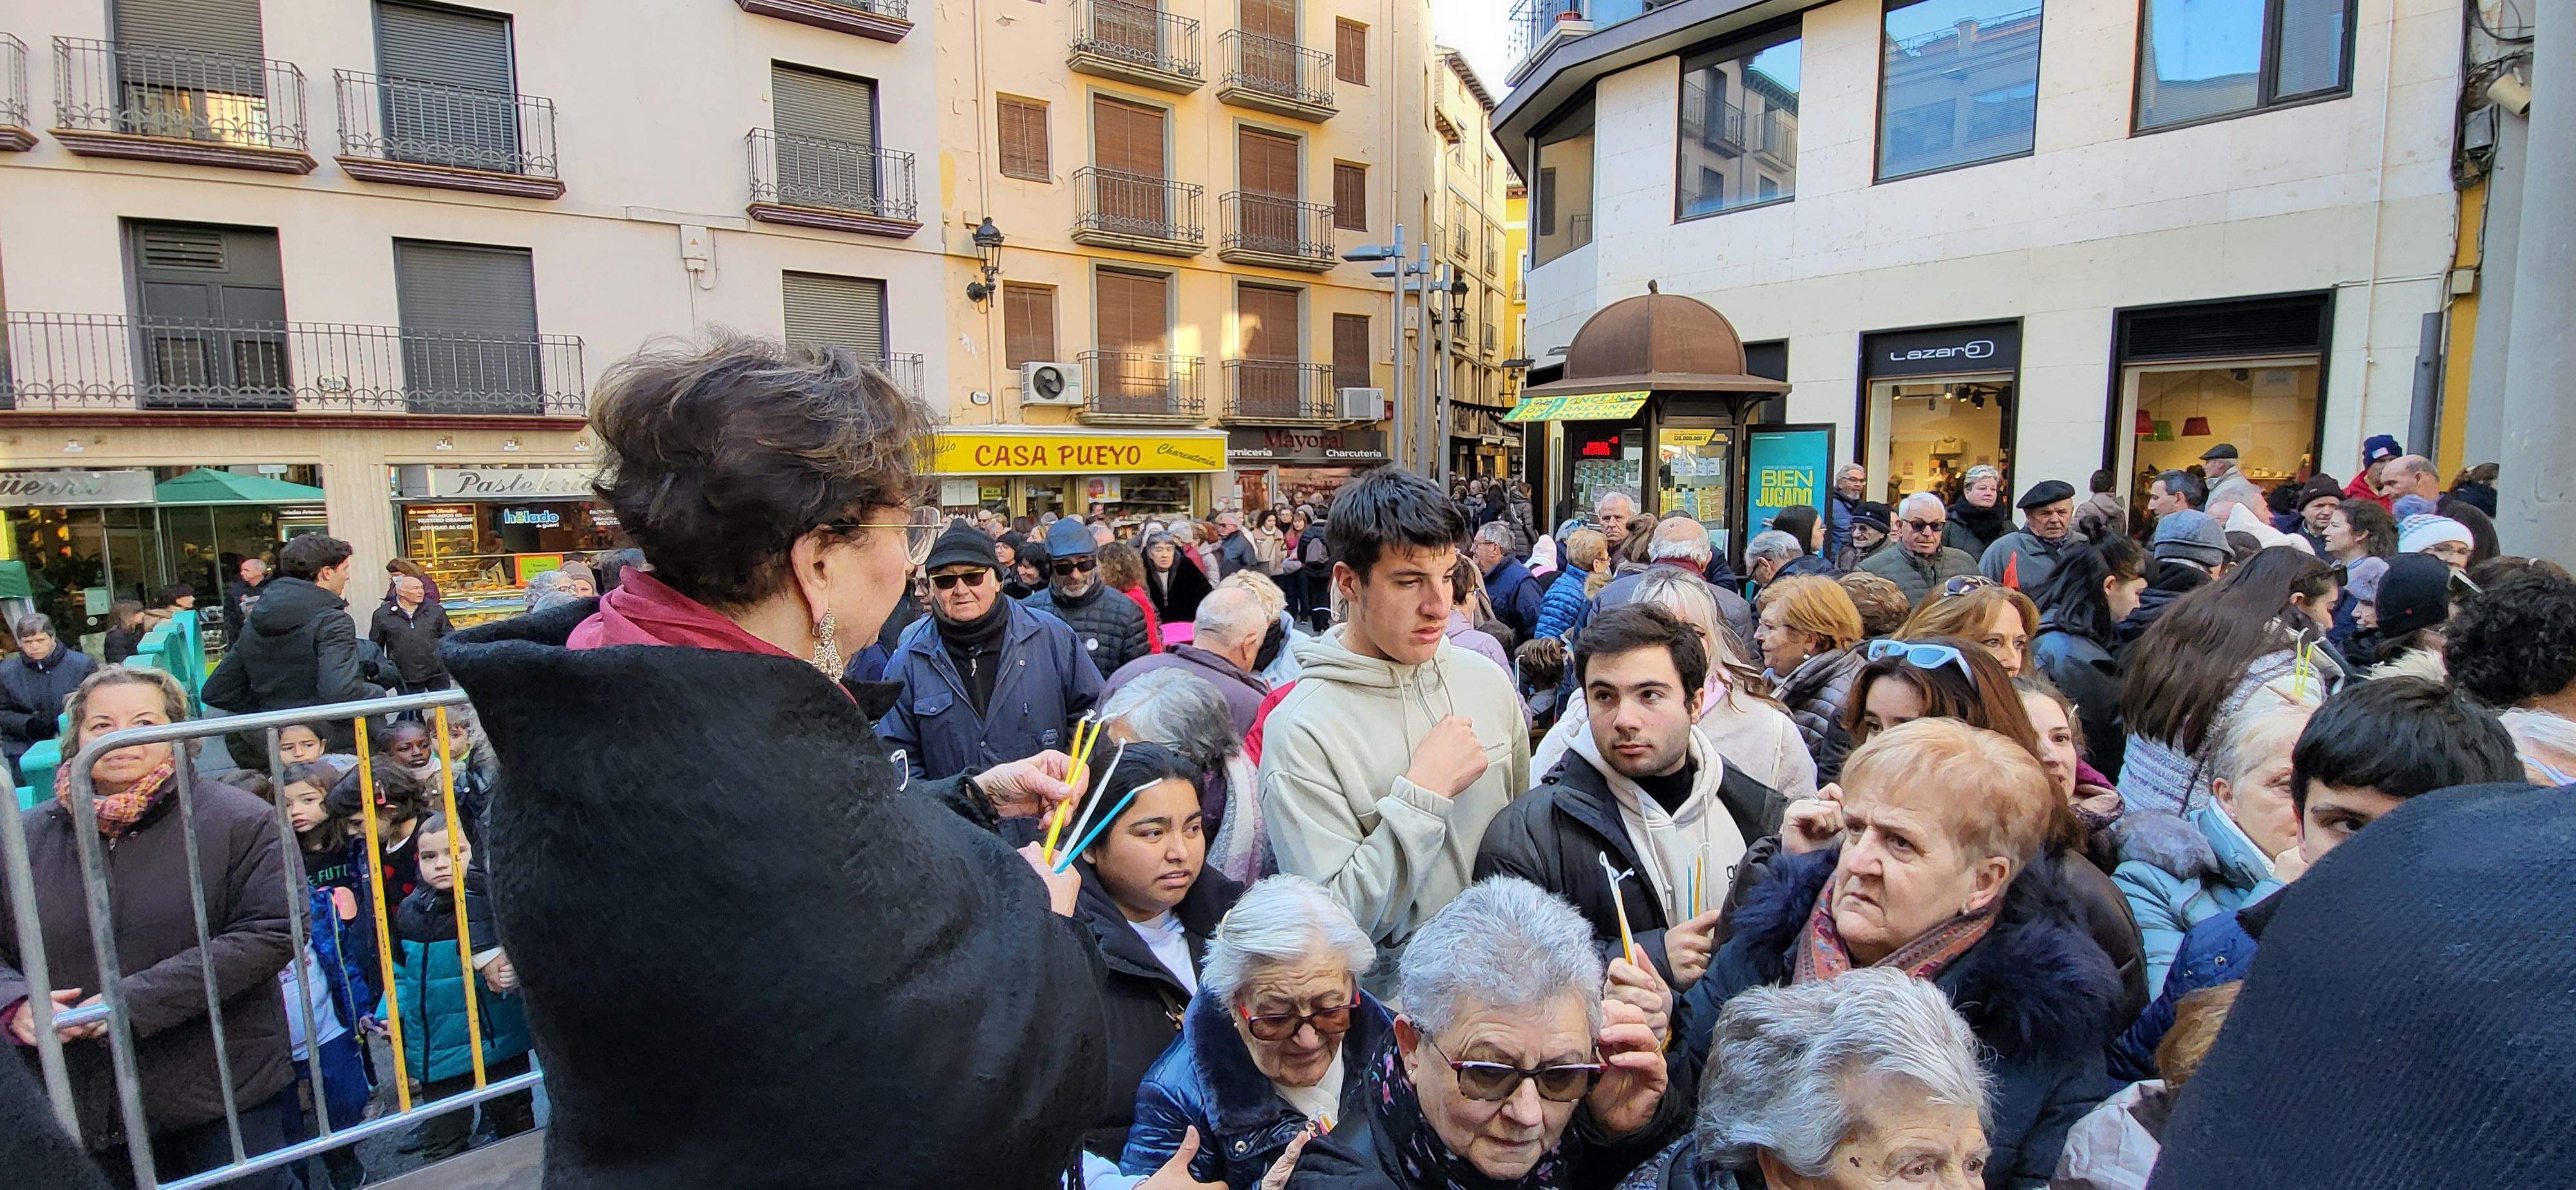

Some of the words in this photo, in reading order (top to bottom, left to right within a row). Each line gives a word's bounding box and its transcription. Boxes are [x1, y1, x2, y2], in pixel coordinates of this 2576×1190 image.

[1263, 429, 1345, 452] Mayoral
[974, 444, 1048, 467] CASA
[1057, 444, 1142, 466] PUEYO
[1227, 448, 1273, 457] arnicería
[1325, 449, 1382, 458] Charcutería
[1761, 469, 1814, 487] BIEN
[1756, 487, 1812, 507] JUGADO
